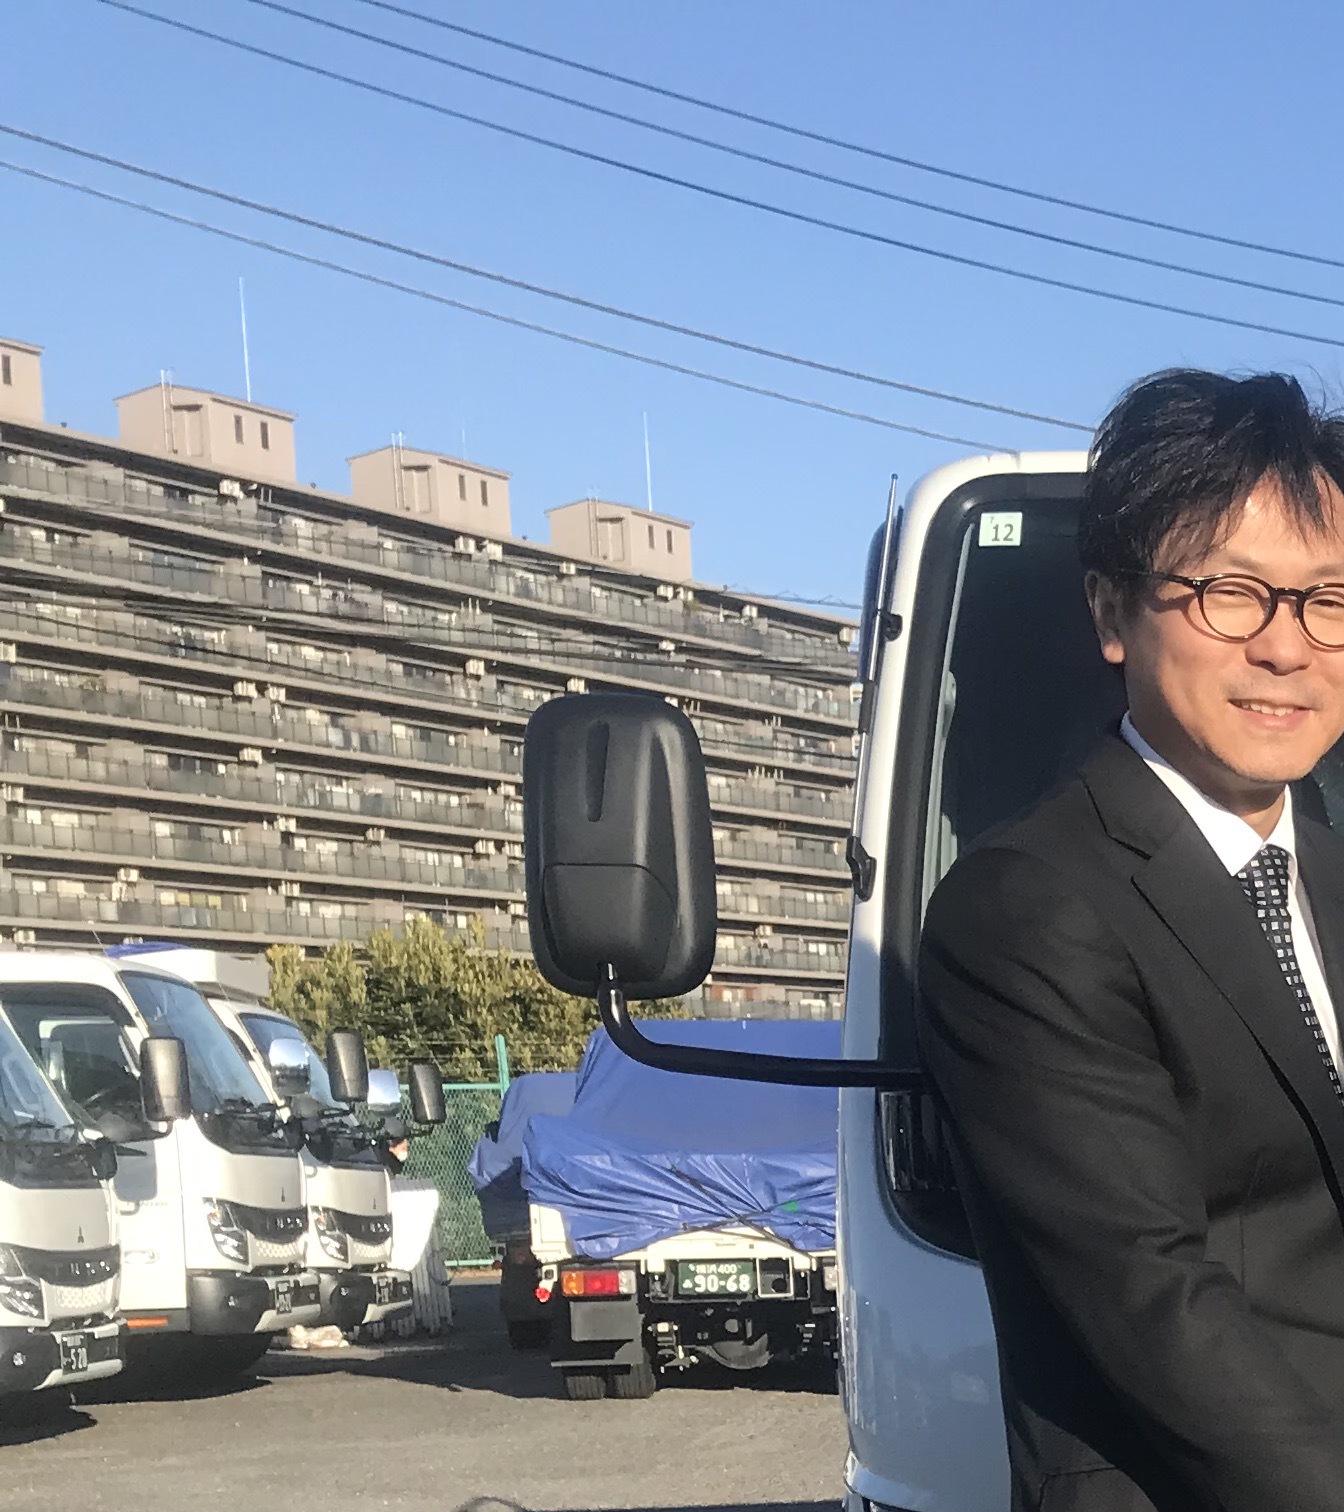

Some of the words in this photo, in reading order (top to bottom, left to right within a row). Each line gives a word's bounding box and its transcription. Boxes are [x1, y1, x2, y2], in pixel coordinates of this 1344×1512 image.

[991, 523, 1014, 542] 12
[718, 1263, 738, 1274] 400
[694, 1273, 751, 1292] 90-68
